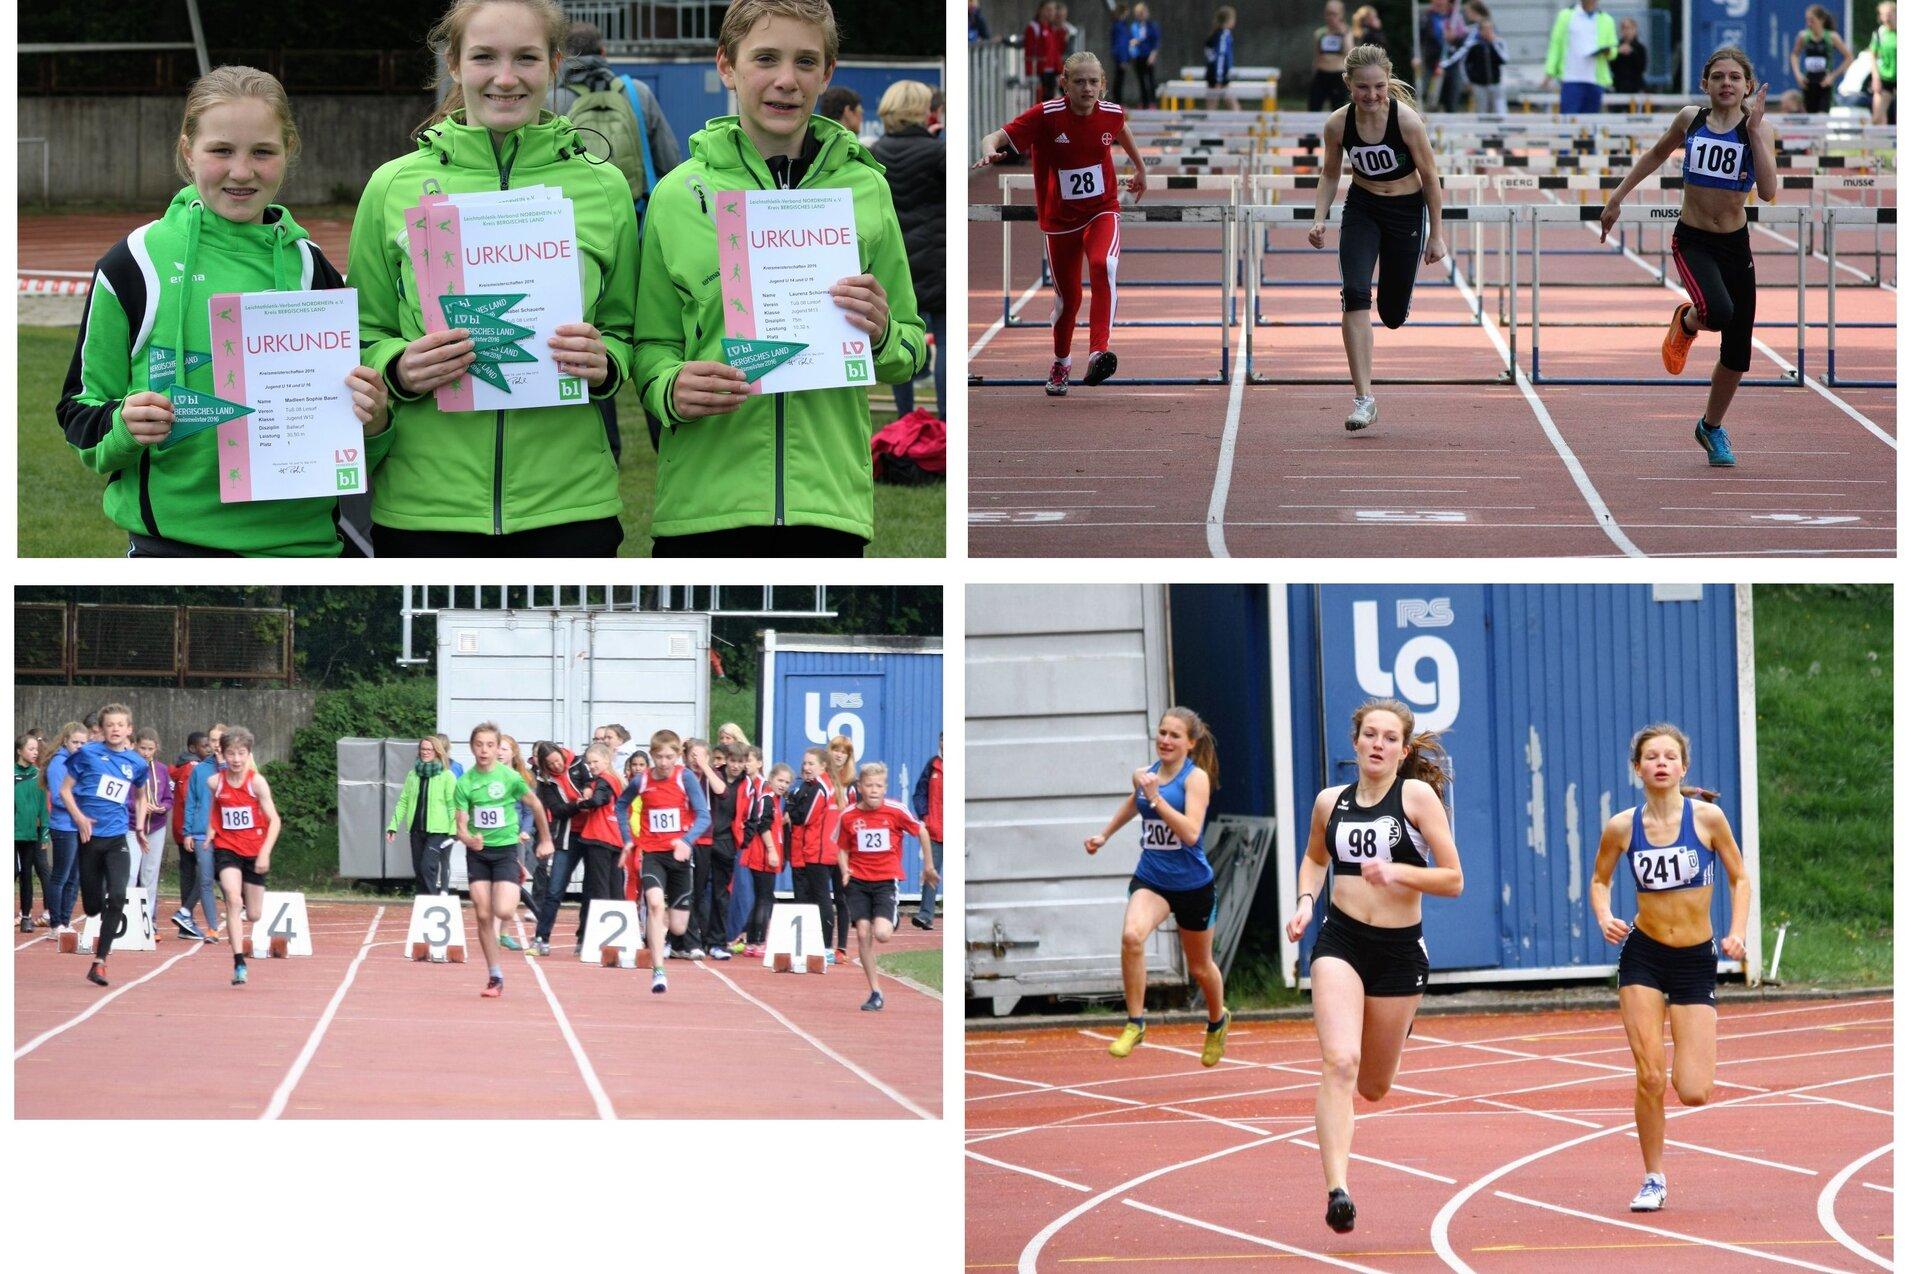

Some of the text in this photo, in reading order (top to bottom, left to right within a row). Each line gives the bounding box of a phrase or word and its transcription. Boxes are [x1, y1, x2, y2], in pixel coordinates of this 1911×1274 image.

[1354, 150, 1393, 172] 100
[1696, 143, 1737, 175] 108
[1070, 172, 1095, 196] 28
[1506, 179, 1533, 187] BERG
[1843, 178, 1875, 187] musse
[496, 218, 528, 226] BERGISCHES
[751, 227, 851, 249] URKUNDE
[466, 240, 571, 266] URKUNDE
[479, 280, 524, 288] Kreismeisterschaften
[488, 298, 507, 311] LAND
[469, 314, 480, 324] bl
[496, 327, 515, 336] LAND
[247, 330, 352, 355] URKUNDE
[740, 343, 754, 353] bl
[156, 349, 166, 360] bl
[184, 355, 198, 365] AND
[500, 346, 519, 357] LAND
[730, 351, 771, 368] BERGISCHES
[770, 346, 789, 357] LAND
[481, 363, 497, 380] LAND
[847, 362, 866, 378] bl
[561, 380, 580, 397] bl
[188, 395, 199, 405] bl
[174, 406, 234, 415] BERGISCHES LAND
[338, 470, 357, 487] bl
[1396, 597, 1455, 628] RS
[829, 692, 864, 709] RS
[105, 780, 123, 798] 67
[225, 810, 250, 826] 186
[481, 811, 497, 825] 99
[653, 813, 675, 829] 181
[865, 833, 882, 848] 23
[1147, 824, 1177, 846] 202
[1348, 828, 1377, 858] 98
[1639, 854, 1681, 884] 241
[267, 902, 298, 943] 4
[421, 905, 452, 947] 3
[599, 910, 628, 953] 2
[791, 915, 803, 957] 1
